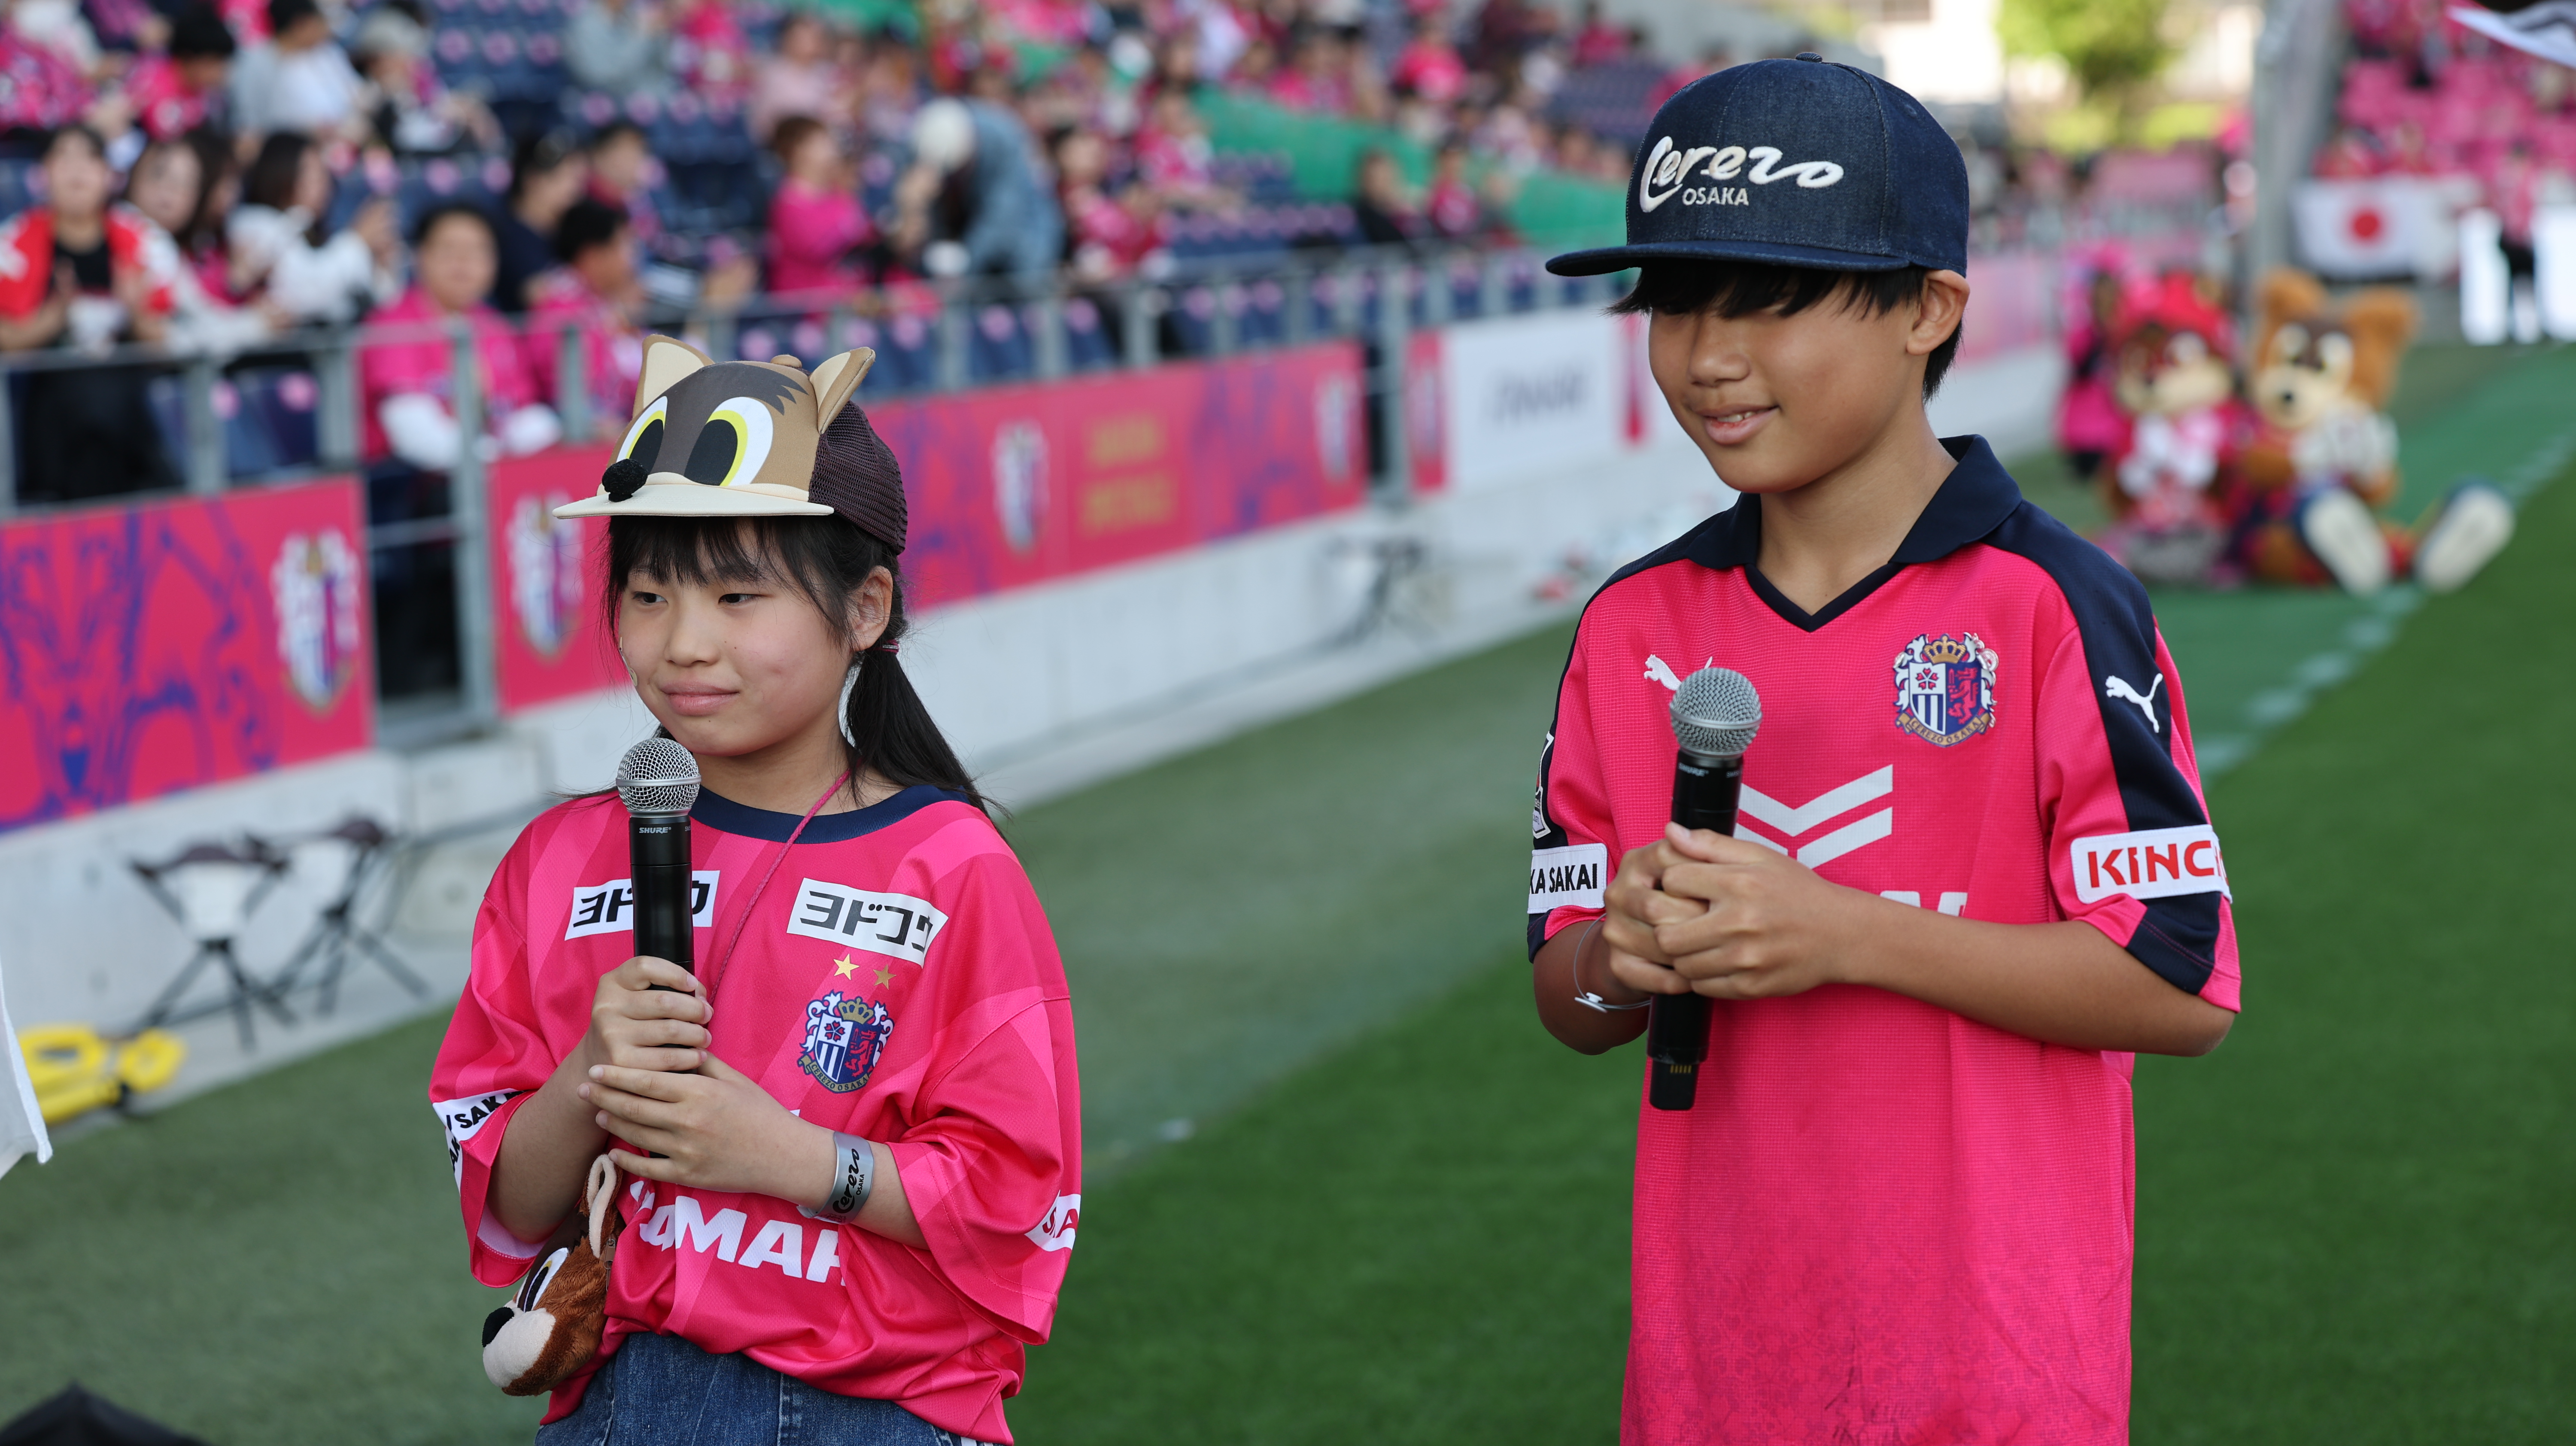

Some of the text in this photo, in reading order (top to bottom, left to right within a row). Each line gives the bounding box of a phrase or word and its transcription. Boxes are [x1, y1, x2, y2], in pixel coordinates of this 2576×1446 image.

[1640, 136, 1844, 213] Cerezo
[1682, 187, 1749, 206] OSAKA
[1911, 720, 1981, 744] CEREZO OSAKA
[1549, 863, 1598, 893] SAKAI
[799, 890, 933, 954] ヨドコウ
[811, 1064, 868, 1091] CEREZO OSAKA
[832, 1148, 860, 1214] Cerezo
[856, 1174, 865, 1195] OSAKA
